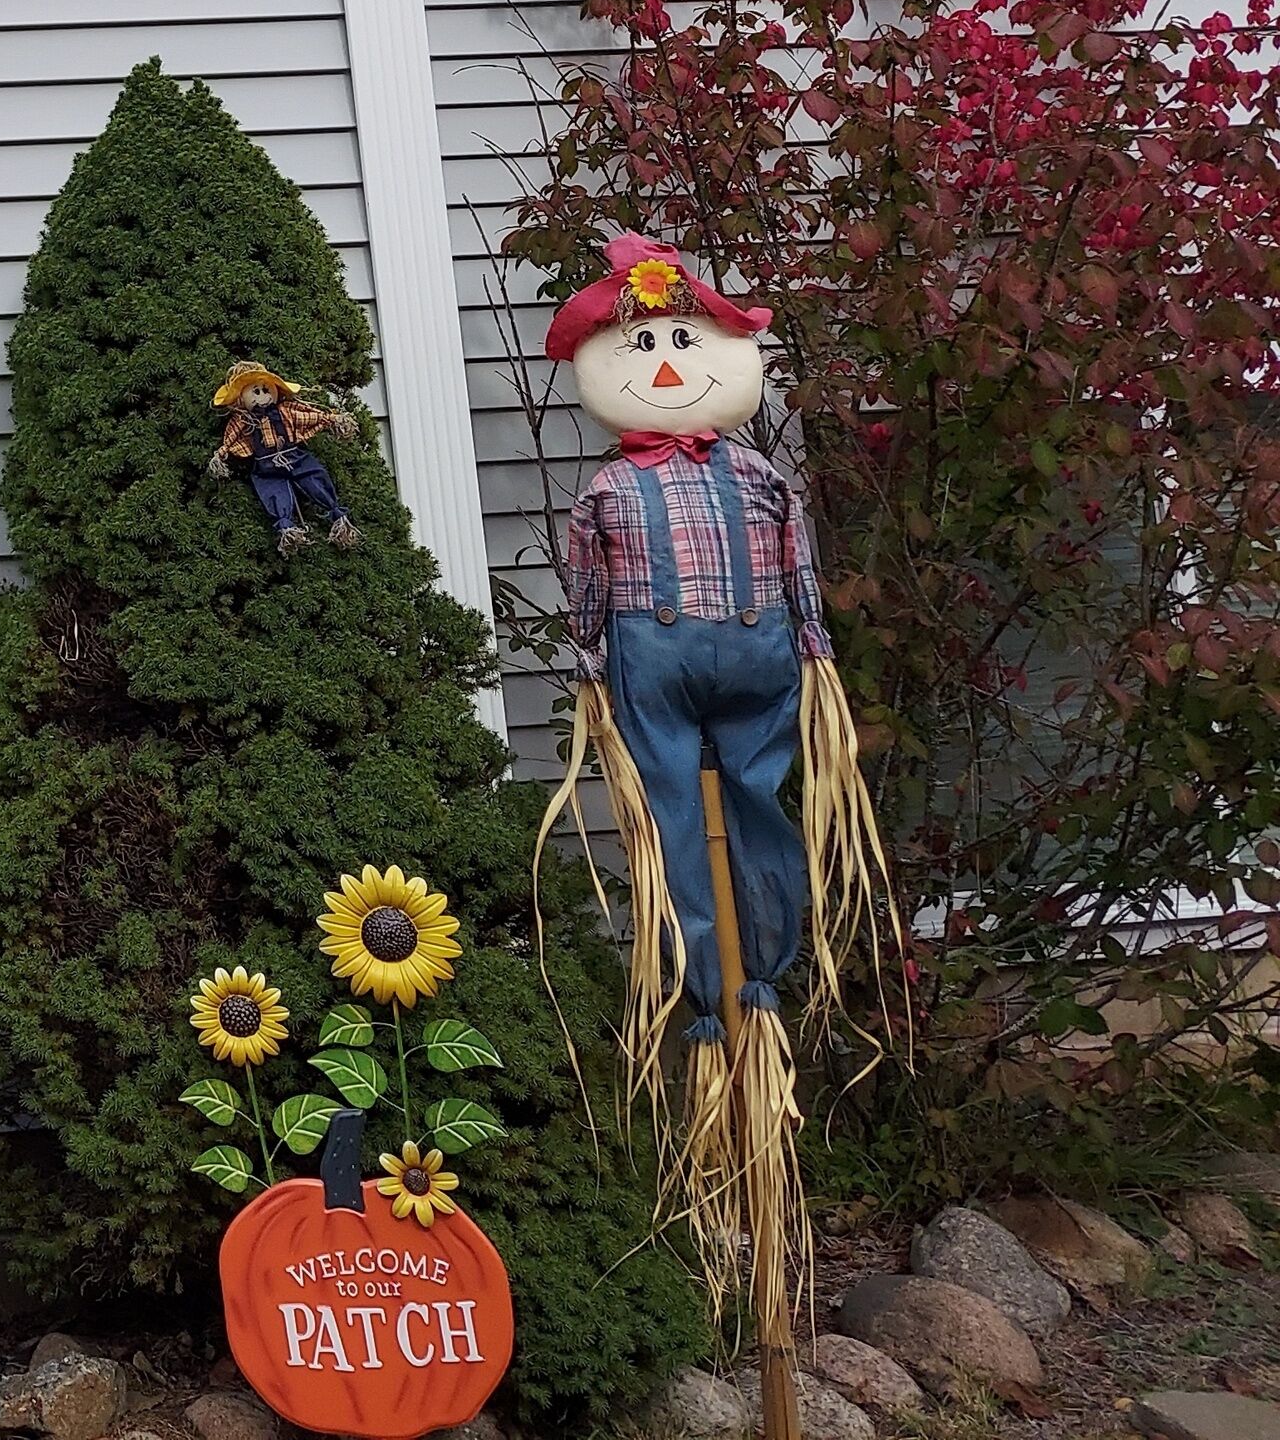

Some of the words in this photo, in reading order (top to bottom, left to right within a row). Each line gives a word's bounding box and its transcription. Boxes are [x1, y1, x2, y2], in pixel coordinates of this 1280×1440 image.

[285, 1247, 450, 1288] WELCOME
[335, 1280, 358, 1297] to
[364, 1280, 402, 1297] our
[278, 1300, 487, 1372] PATCH
